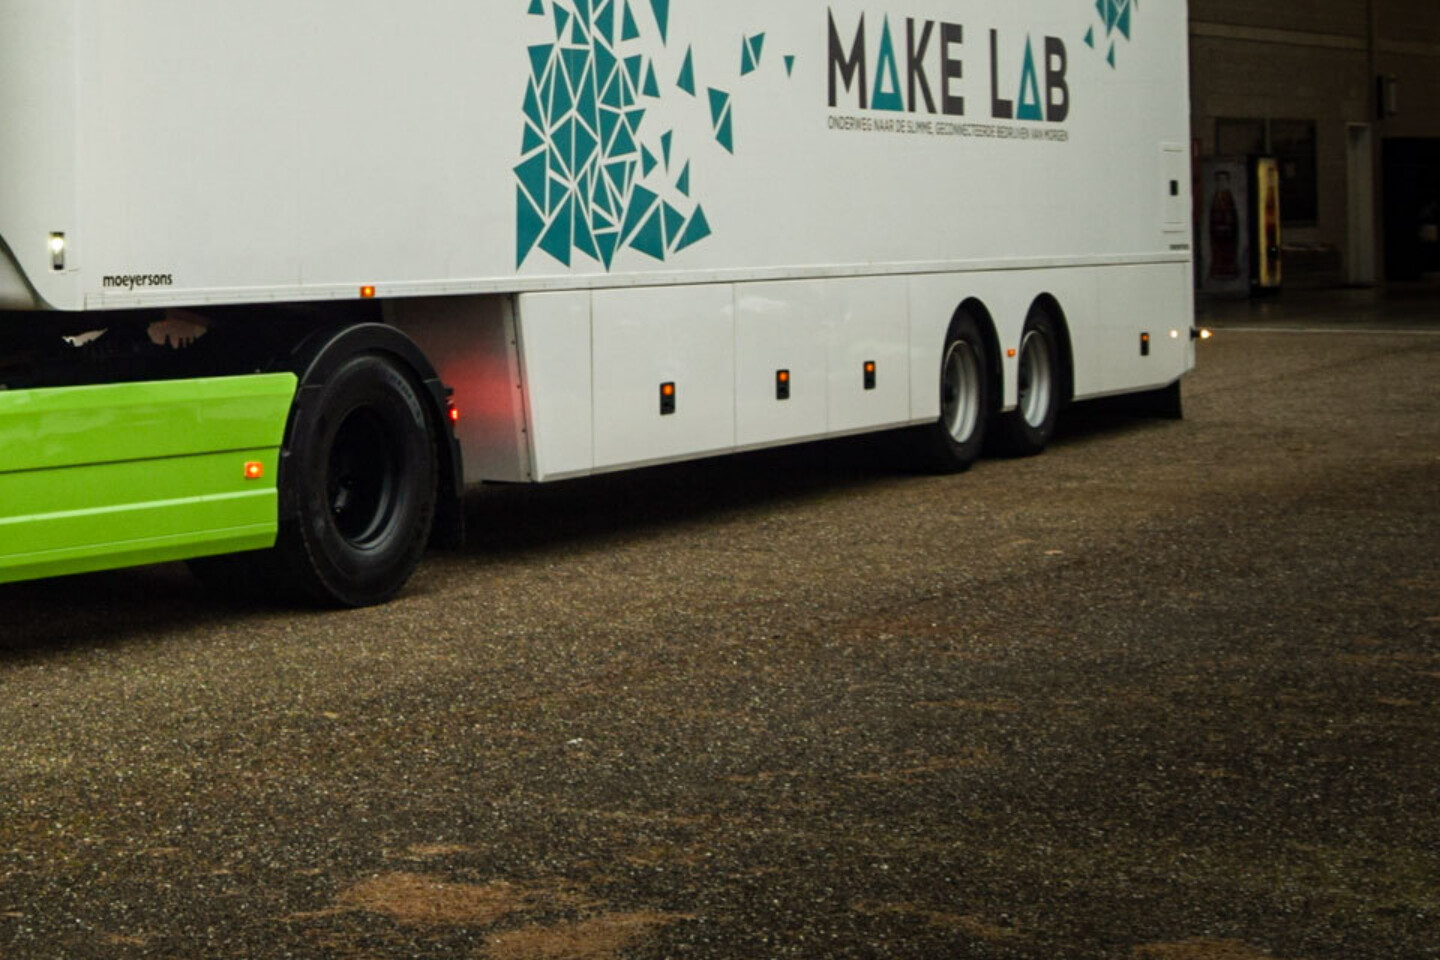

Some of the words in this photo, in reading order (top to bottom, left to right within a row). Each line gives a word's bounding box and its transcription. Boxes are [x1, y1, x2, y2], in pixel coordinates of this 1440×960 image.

[828, 5, 965, 116] MAKE
[990, 28, 1070, 122] LAB
[828, 115, 872, 132] ONDERWEG
[103, 273, 173, 290] moeyersons
